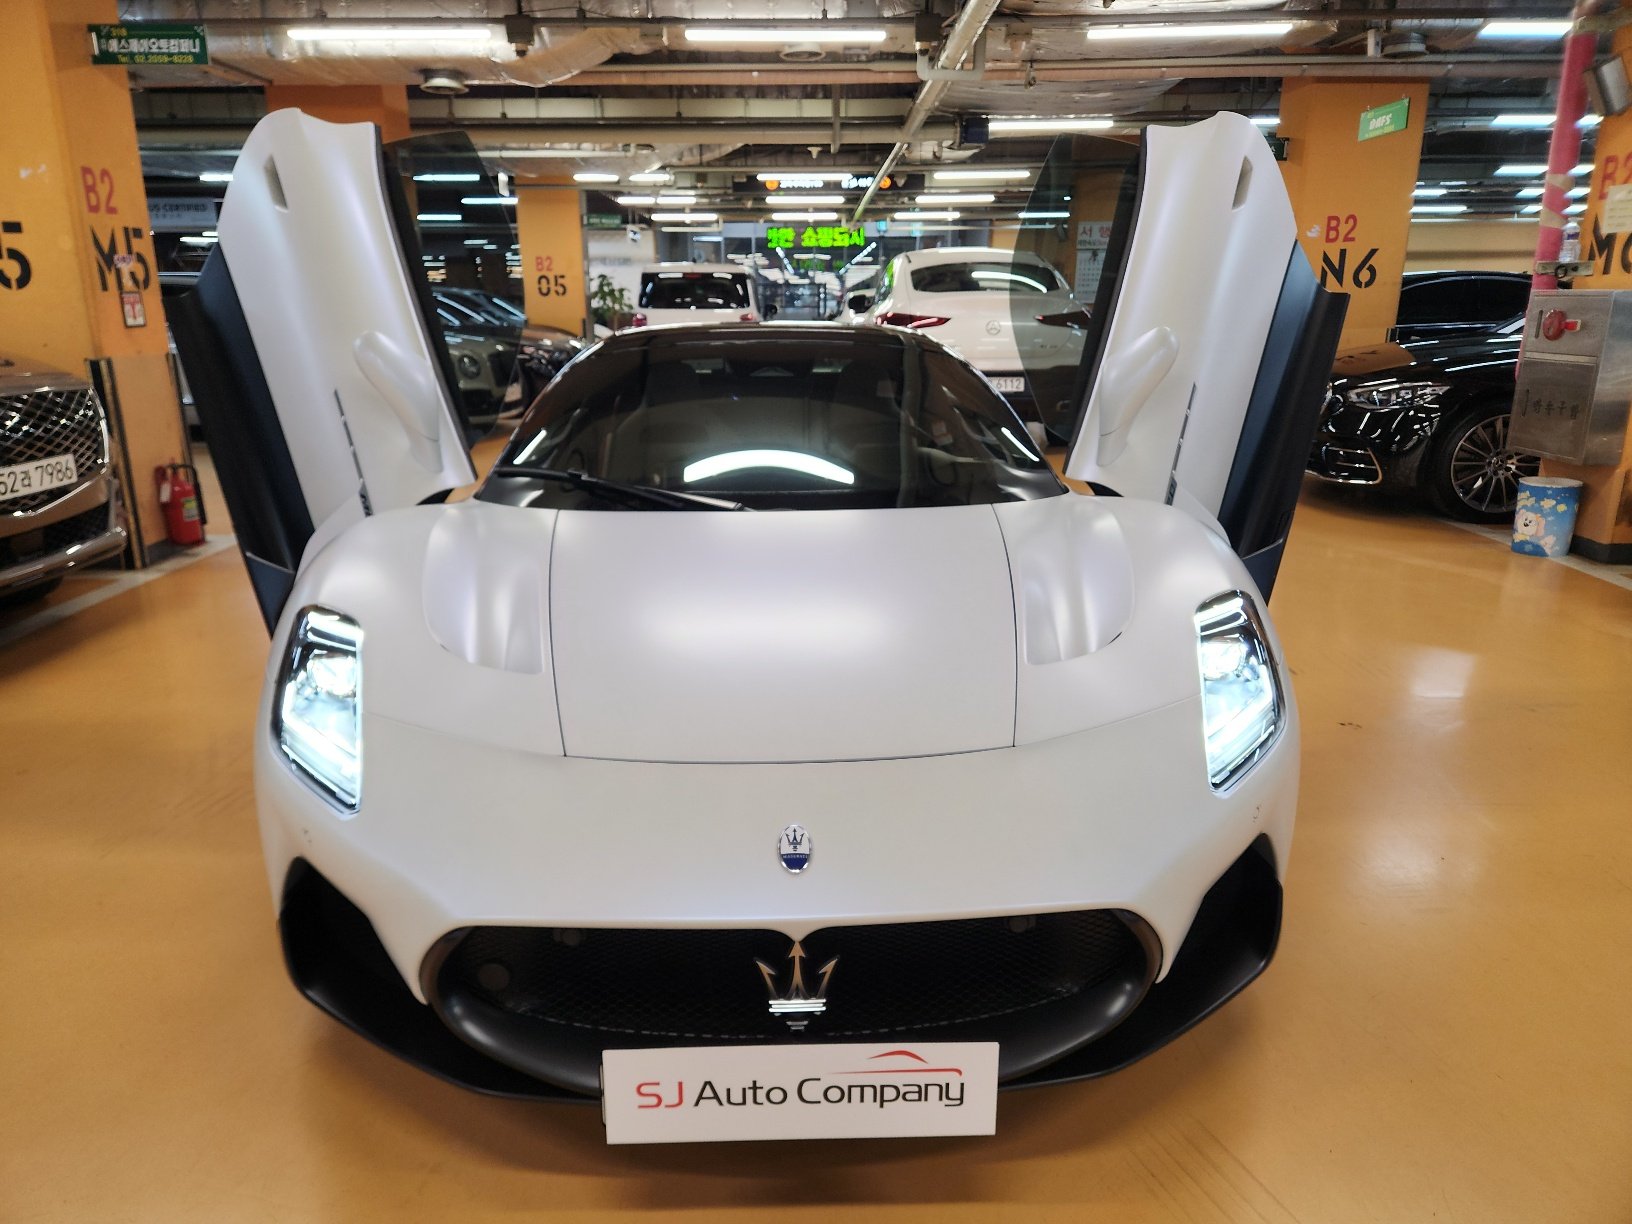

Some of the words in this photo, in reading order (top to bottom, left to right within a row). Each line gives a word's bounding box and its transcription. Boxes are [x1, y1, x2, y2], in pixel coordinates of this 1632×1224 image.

[81, 165, 118, 215] B2
[1325, 213, 1358, 244] B2
[89, 223, 151, 292] M5
[535, 255, 554, 272] B2
[1319, 247, 1380, 289] N6
[996, 379, 1021, 393] 6112
[34, 458, 74, 487] 7986
[635, 1081, 684, 1109] SJ
[693, 1079, 788, 1108] Auto
[796, 1078, 966, 1109] Company
